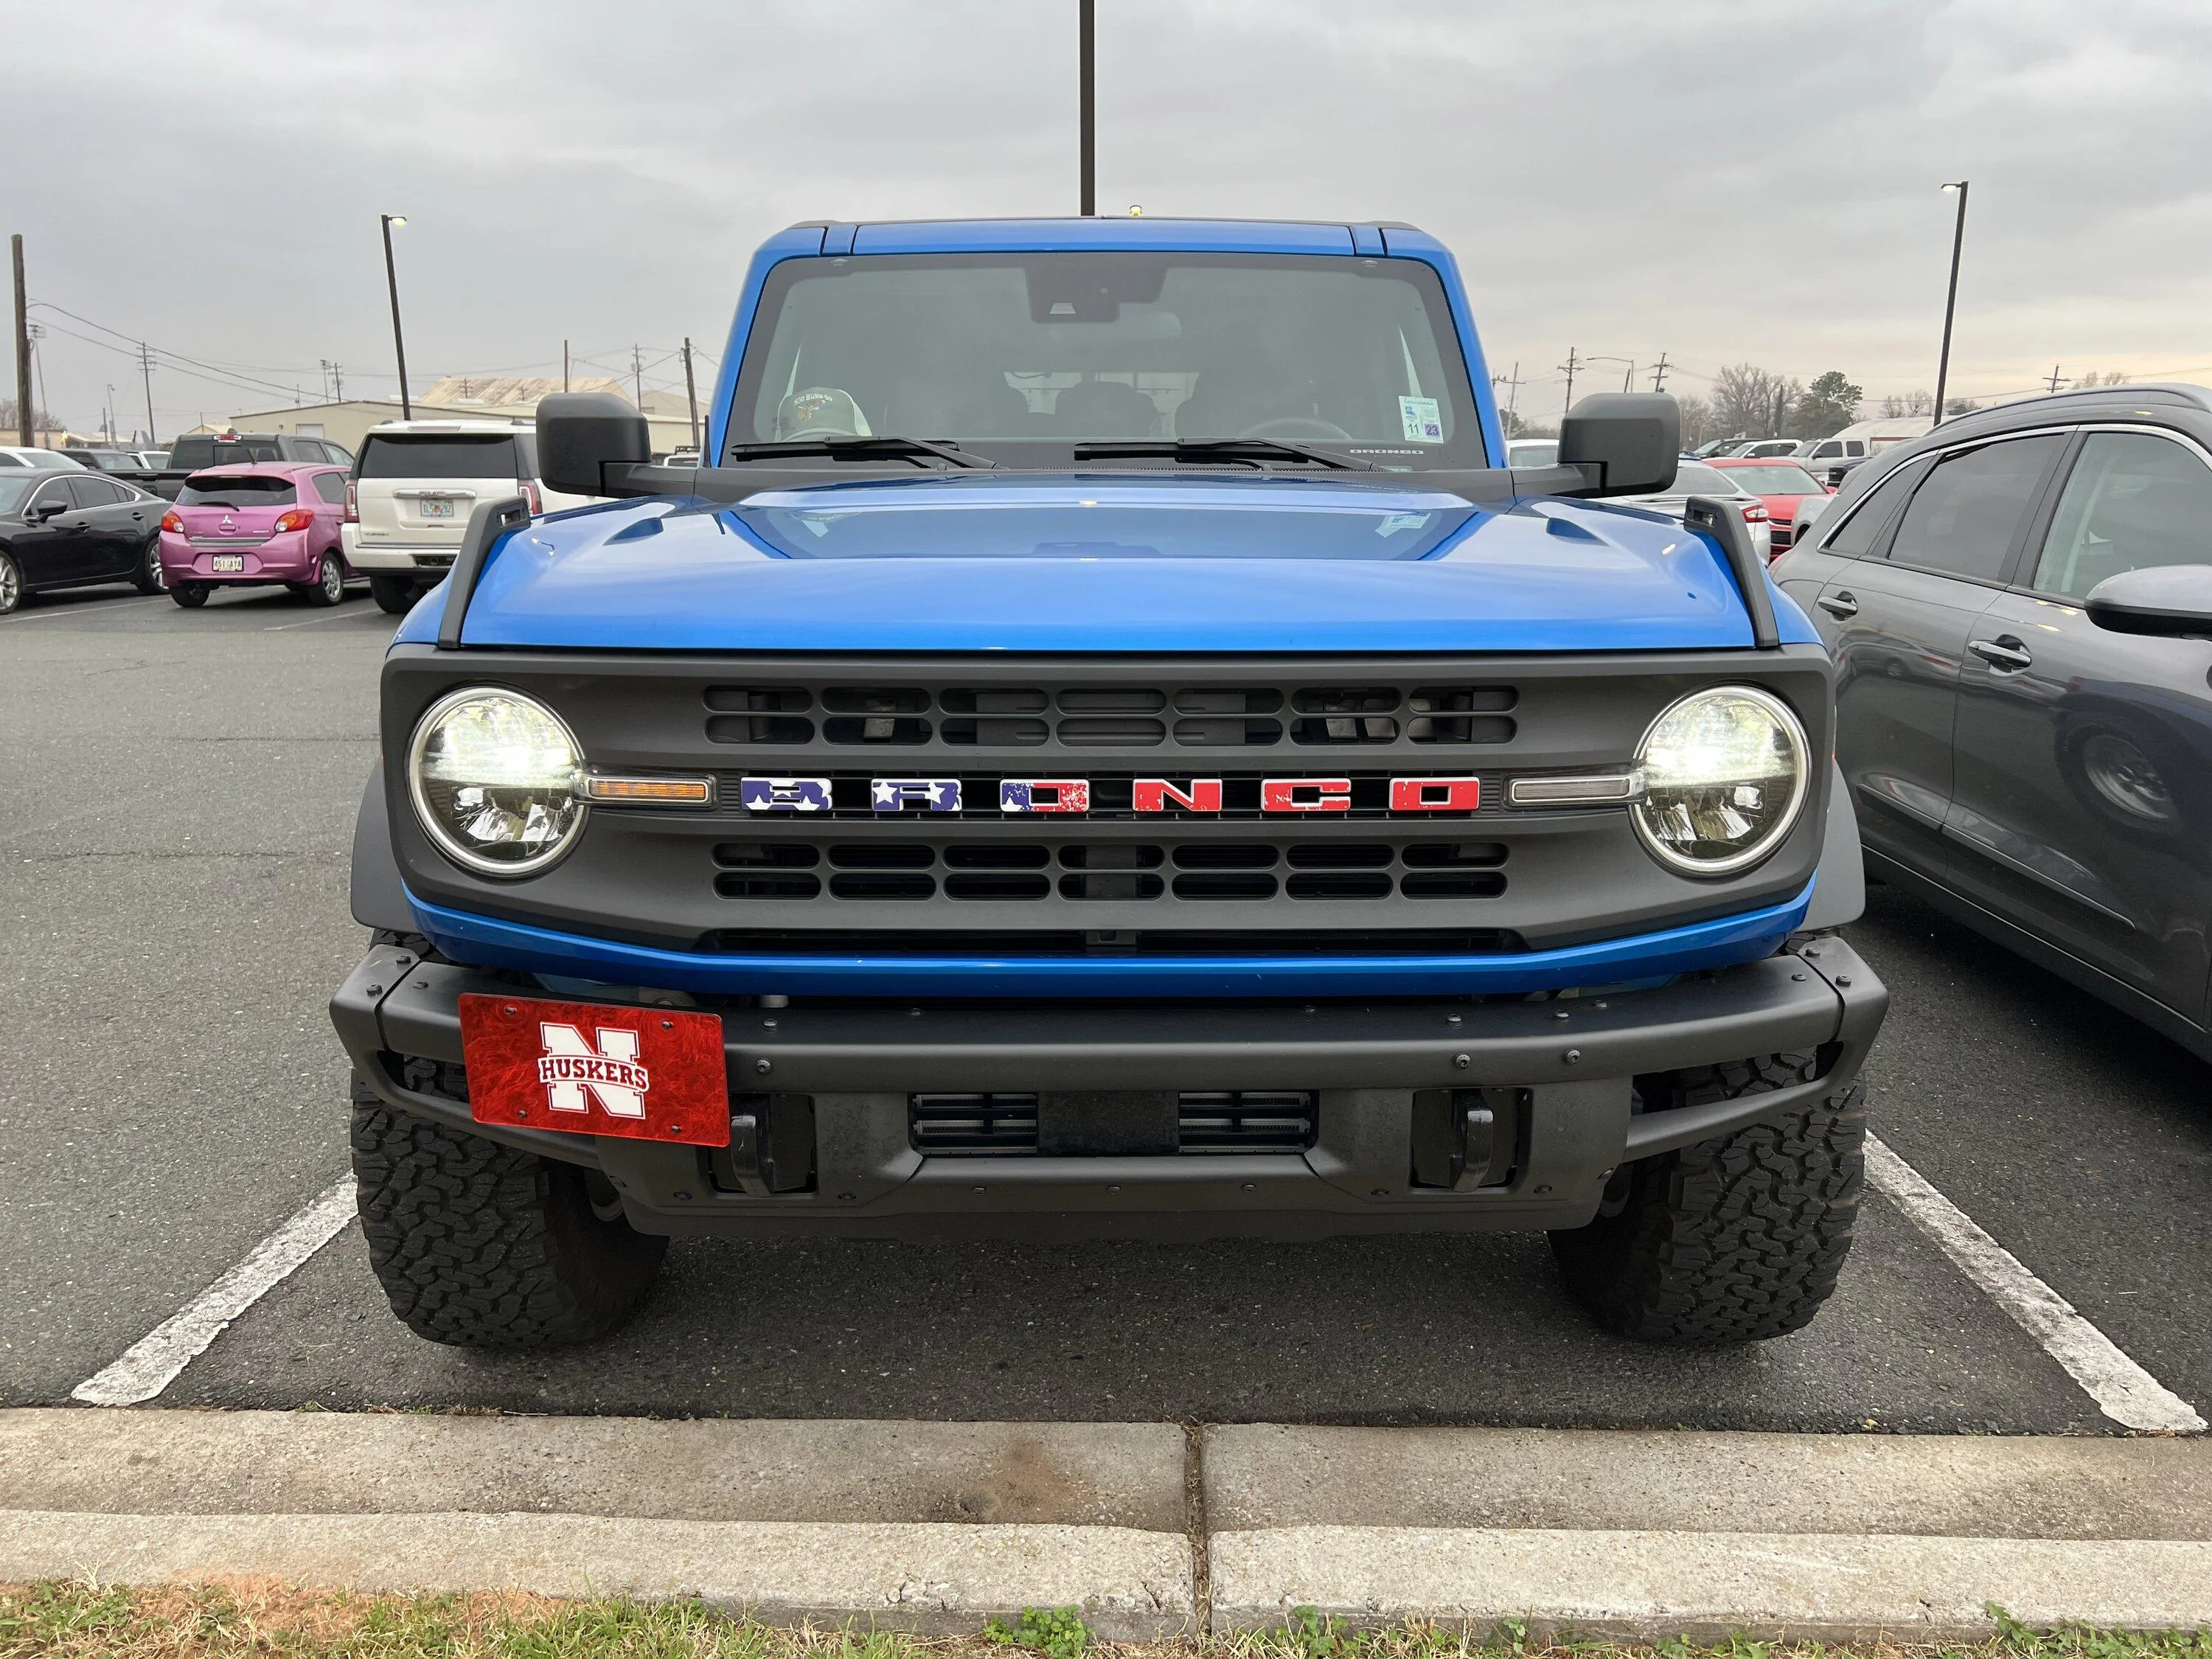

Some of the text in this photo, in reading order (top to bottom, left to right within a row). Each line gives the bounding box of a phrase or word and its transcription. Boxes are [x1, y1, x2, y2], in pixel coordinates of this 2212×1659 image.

[1408, 423, 1419, 434] 11
[1426, 425, 1439, 436] 23
[740, 776, 1481, 813] BRONCO
[540, 1022, 645, 1120] N
[540, 1060, 647, 1090] HUSKERS
